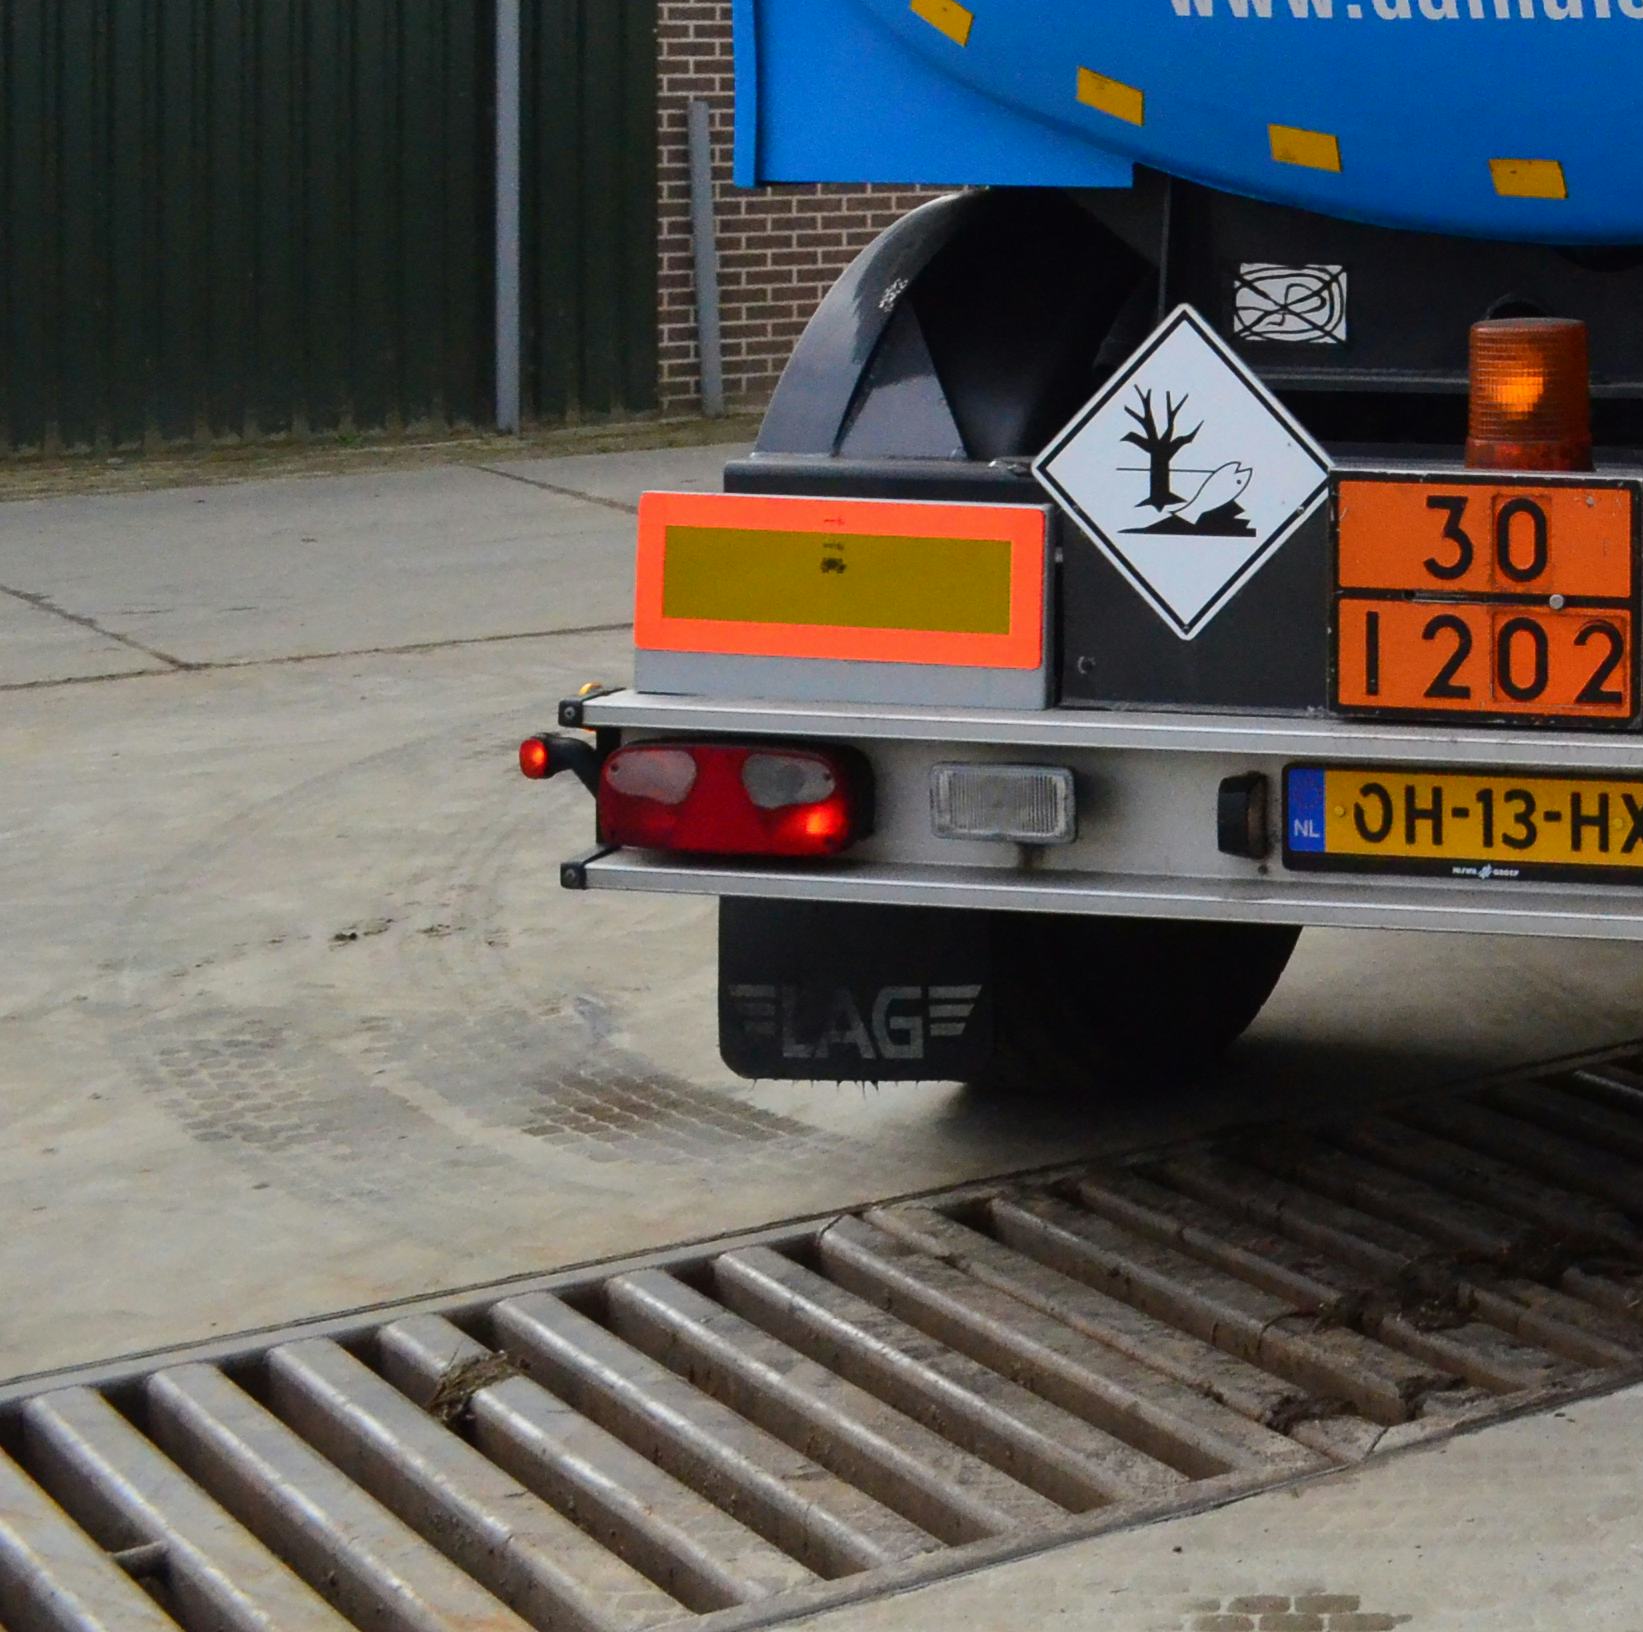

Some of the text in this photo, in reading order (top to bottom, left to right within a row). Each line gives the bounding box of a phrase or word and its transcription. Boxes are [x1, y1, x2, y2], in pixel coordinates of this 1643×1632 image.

[1423, 495, 1548, 583] 30
[1365, 610, 1624, 705] 1202
[1293, 818, 1320, 838] NL
[781, 984, 925, 1060] LAG
